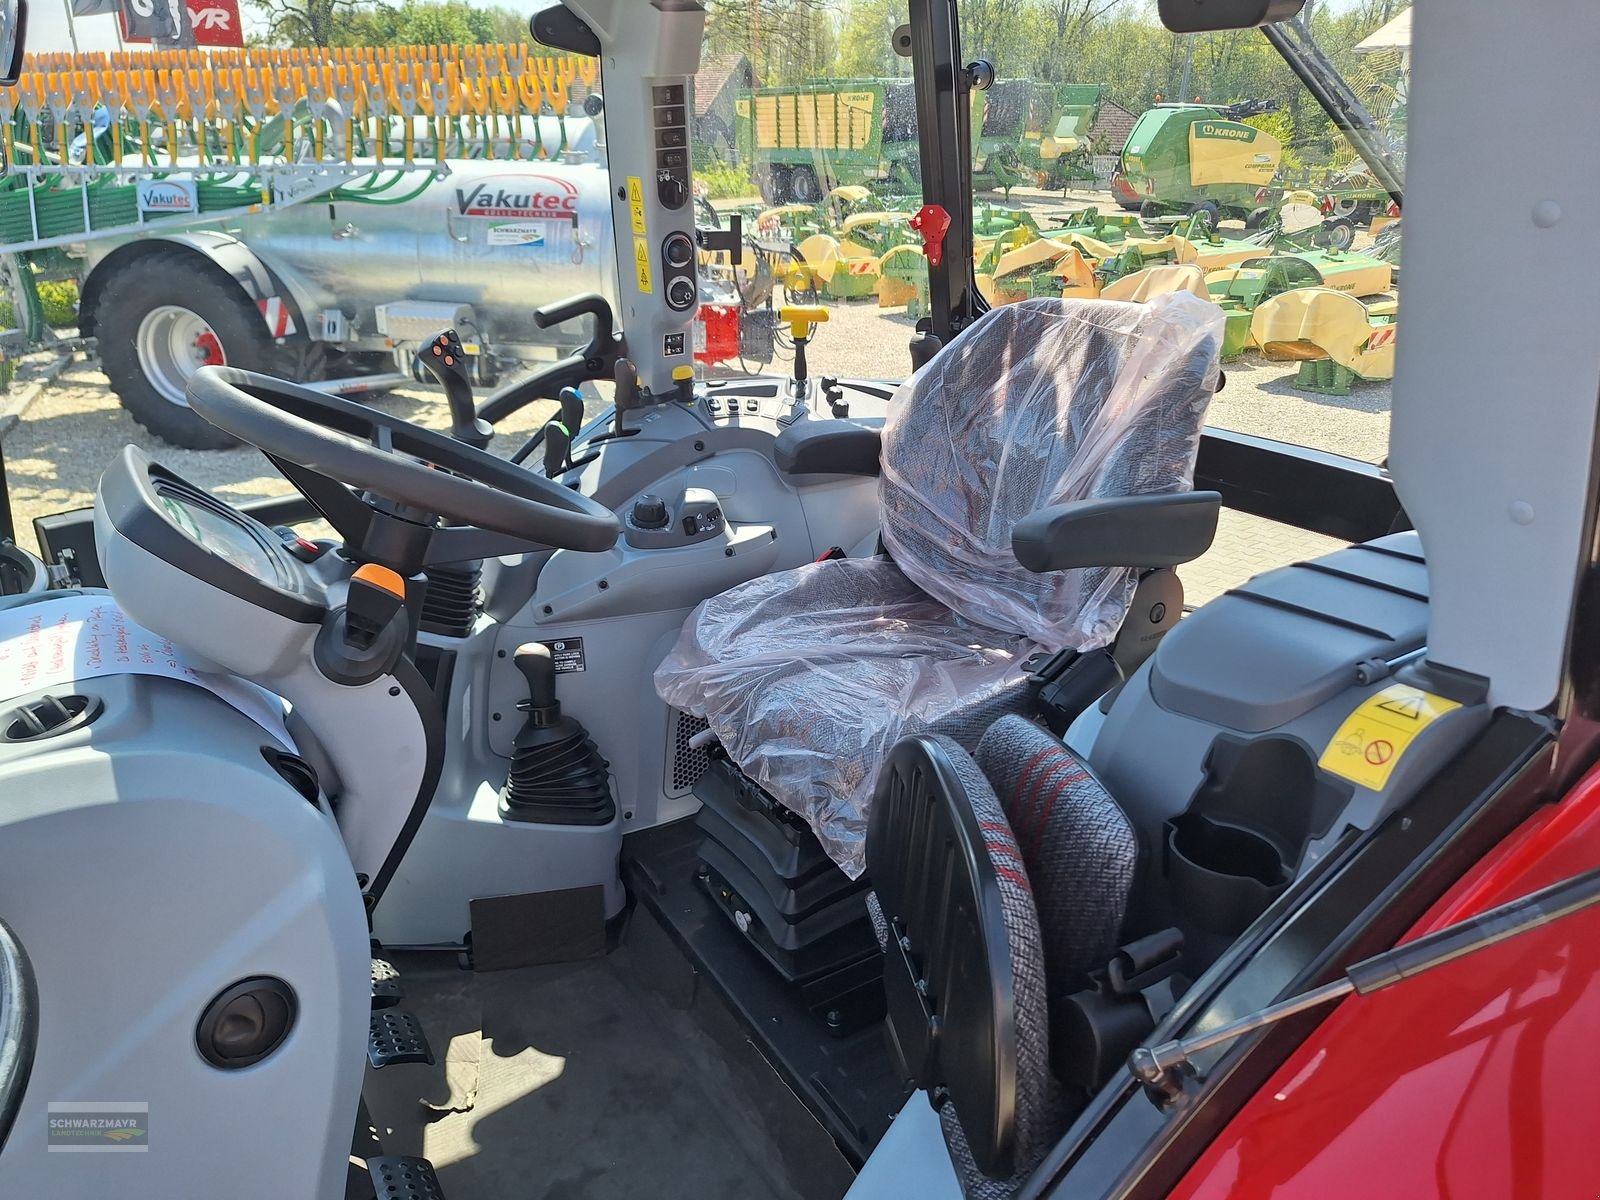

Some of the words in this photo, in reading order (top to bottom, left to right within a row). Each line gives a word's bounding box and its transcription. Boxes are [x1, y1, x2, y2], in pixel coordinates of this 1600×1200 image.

[1214, 127, 1250, 139] KRONE
[143, 190, 191, 207] Vakutec
[456, 183, 578, 215] Vakutec
